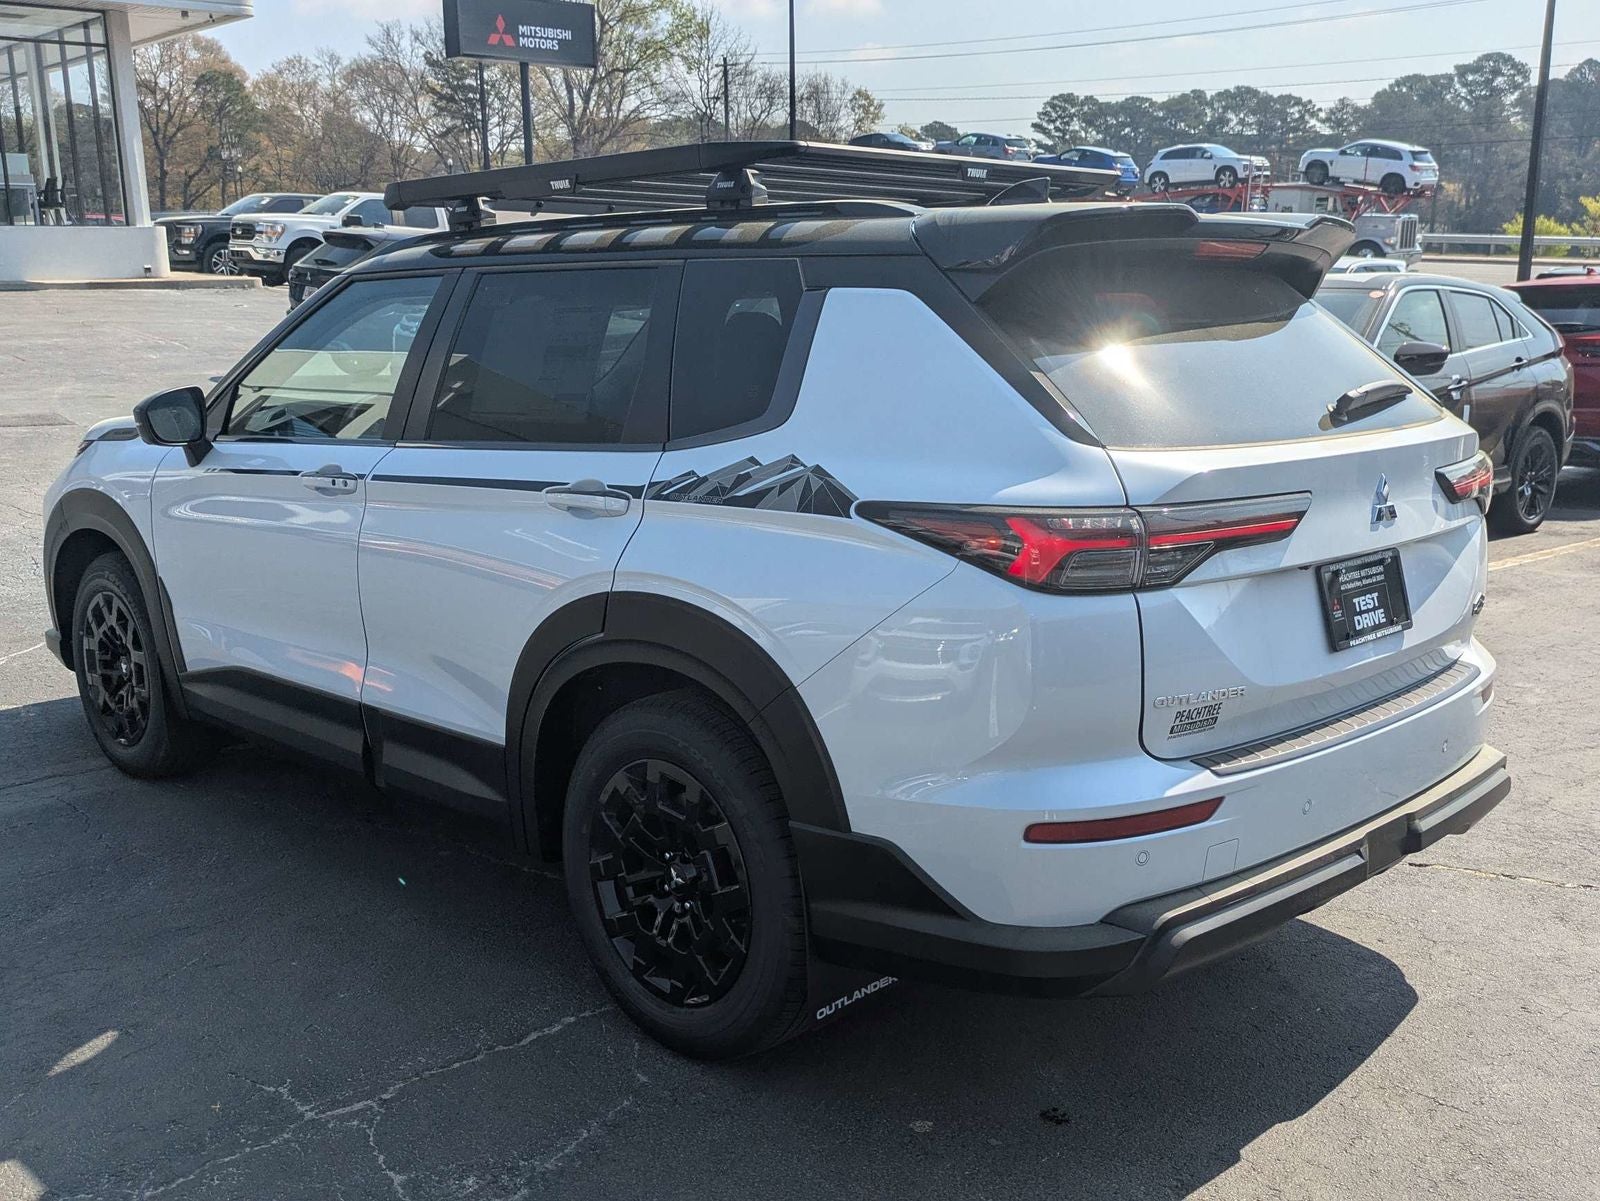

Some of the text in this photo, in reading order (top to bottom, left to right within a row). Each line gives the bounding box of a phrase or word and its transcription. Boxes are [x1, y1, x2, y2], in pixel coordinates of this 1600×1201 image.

[518, 25, 572, 40] MITSUBISHI
[519, 37, 559, 50] MOTORS
[967, 167, 988, 179] THULE
[550, 179, 571, 190] THULE
[1353, 592, 1379, 612] TEST
[1354, 608, 1387, 631] DRIVE
[1349, 625, 1403, 647] PEACHTREE MITSUBISHI
[1153, 685, 1247, 708] OUTLANDER
[1173, 702, 1223, 724] PEACHTREE
